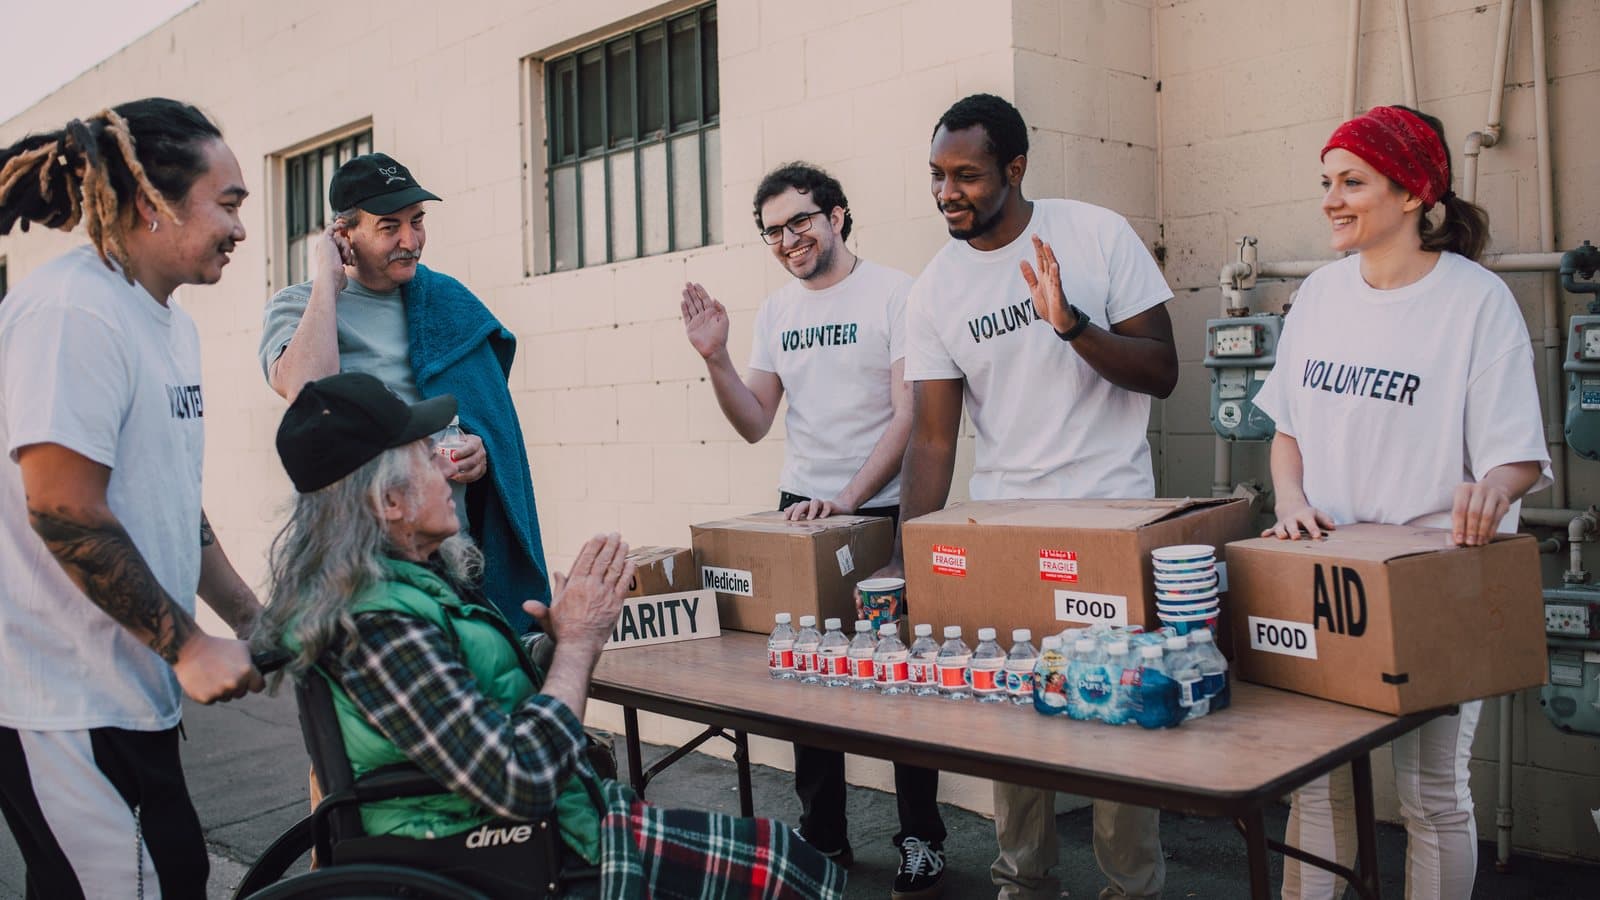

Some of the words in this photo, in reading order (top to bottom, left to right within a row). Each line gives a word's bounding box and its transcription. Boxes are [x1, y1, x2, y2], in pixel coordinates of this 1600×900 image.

[782, 323, 858, 352] VOLUNTEER
[1302, 359, 1421, 406] VOLUNTEER
[935, 554, 964, 567] FRAGILE
[1043, 561, 1074, 572] FRAGILE
[704, 569, 750, 593] Medicine
[1065, 598, 1116, 619] FOOD
[1313, 563, 1368, 638] AID
[612, 597, 700, 642] ARITY
[1256, 622, 1308, 650] FOOD
[465, 824, 532, 849] drive
